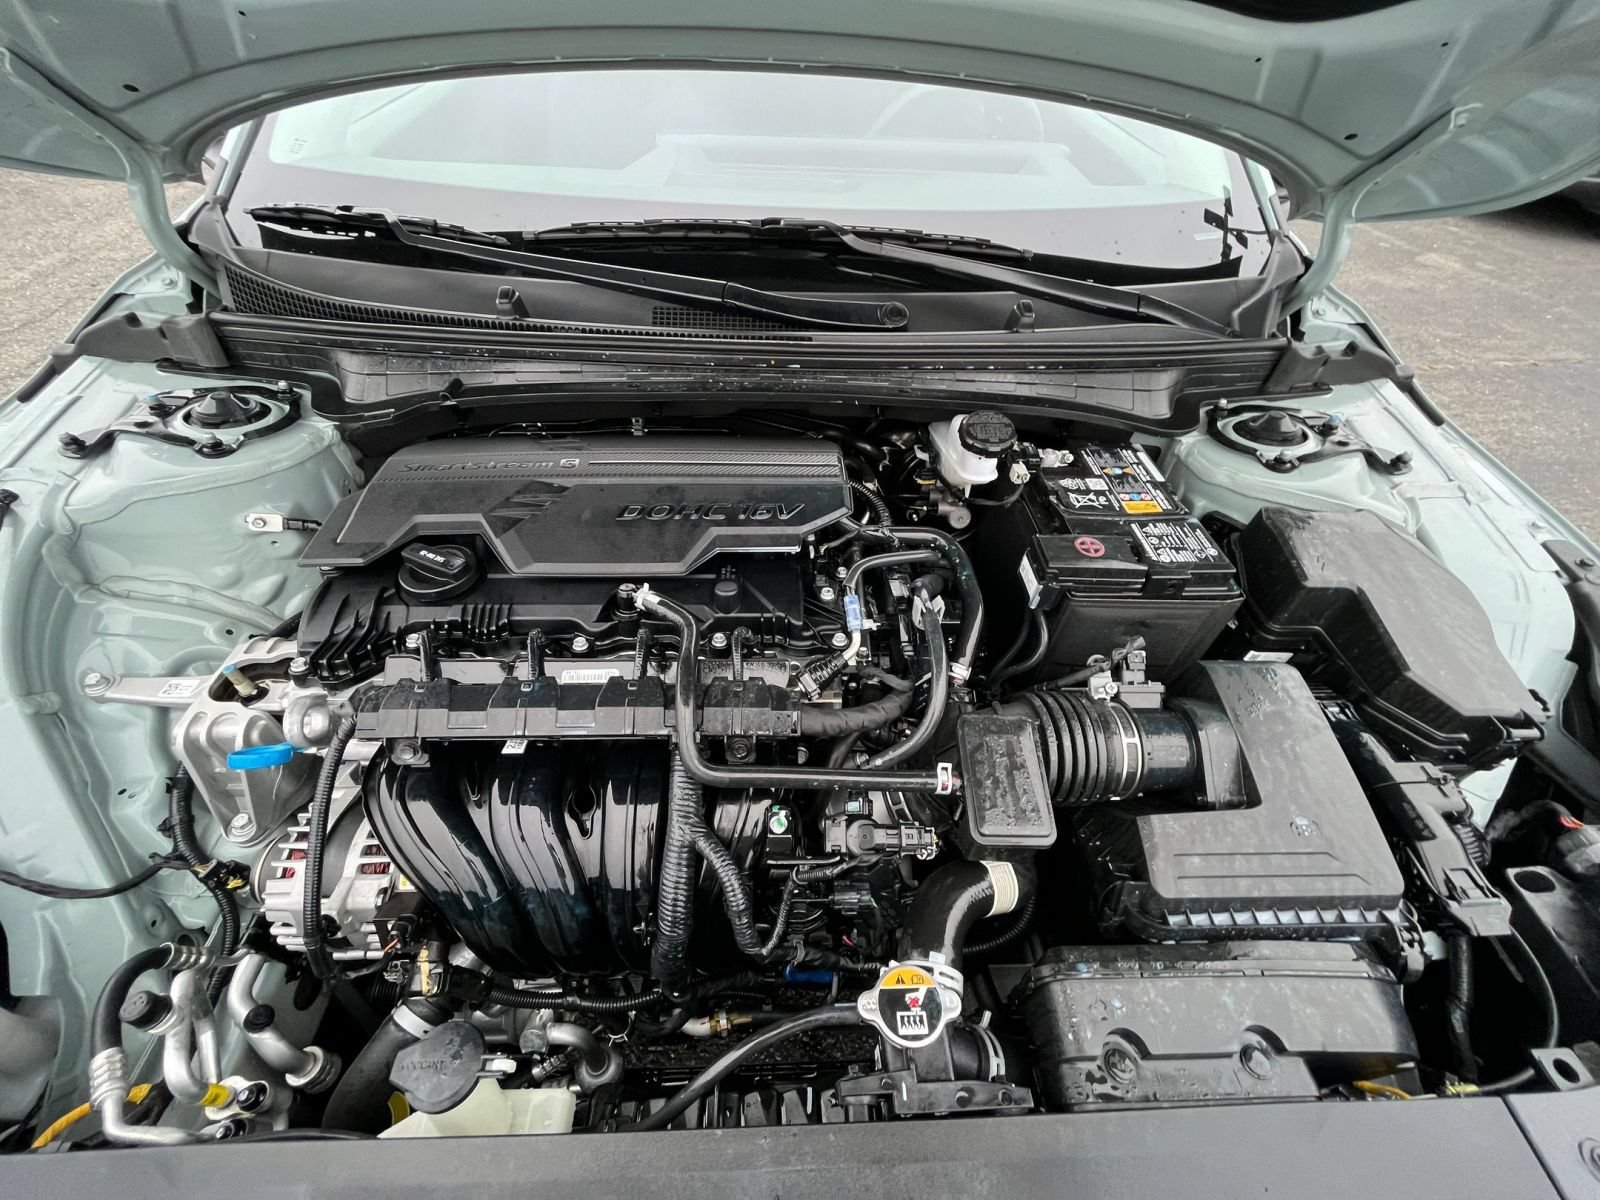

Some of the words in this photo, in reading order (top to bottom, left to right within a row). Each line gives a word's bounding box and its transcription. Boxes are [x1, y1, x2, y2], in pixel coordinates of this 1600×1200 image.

[399, 461, 554, 473] Smartstream
[615, 502, 732, 521] DOHC
[738, 502, 805, 520] 16V
